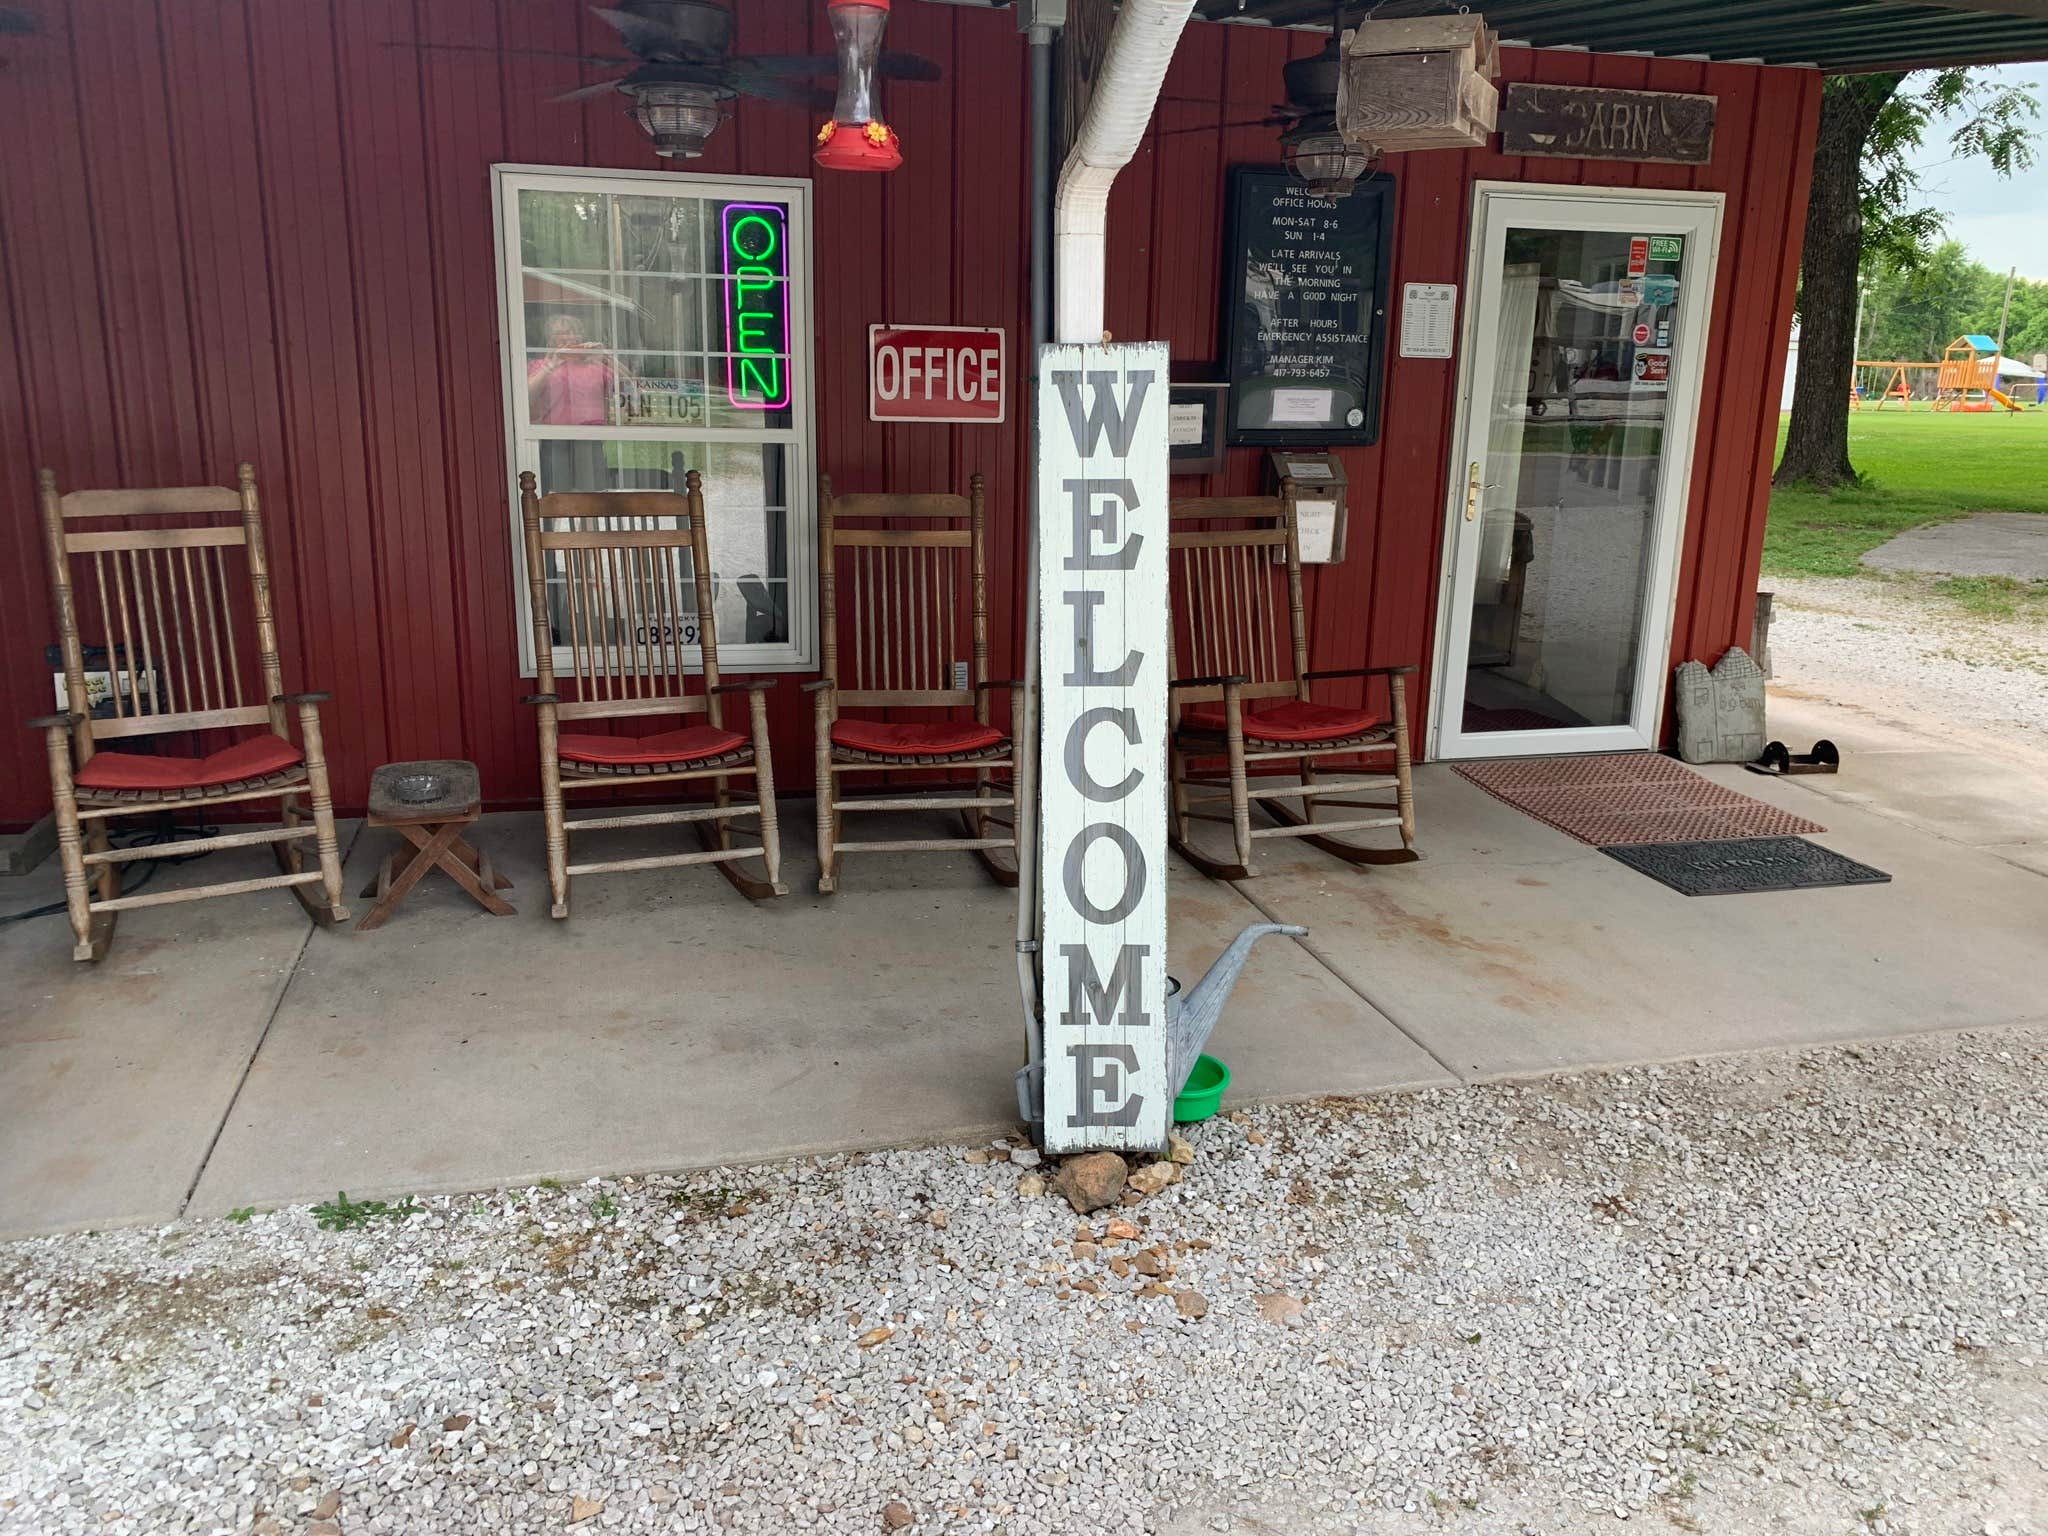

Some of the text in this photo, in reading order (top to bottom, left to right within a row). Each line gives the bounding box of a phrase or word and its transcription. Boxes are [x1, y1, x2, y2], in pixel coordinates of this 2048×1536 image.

[1286, 186, 1311, 196] WELC
[1272, 197, 1337, 209] OFFICE HOURS
[1272, 216, 1339, 229] MON-SAT 8-6
[1284, 230, 1325, 241] SUN 1-4
[1271, 249, 1341, 261] LATE ARRIVALS
[1259, 262, 1353, 275] WE'LL SEE YOU IN
[1275, 278, 1341, 288] THE MORNING
[1254, 290, 1358, 302] HAVE A GOOD NIGHT
[732, 215, 779, 399] OPEN
[1270, 318, 1338, 329] AFTER HOURS
[1257, 332, 1368, 343] EMERGENCY ASSISTANCE
[1269, 354, 1334, 364] MANAGER KIM
[1648, 359, 1668, 367] Good
[876, 345, 999, 402] OFFICE
[1272, 368, 1331, 378] 417-793-6457
[636, 380, 679, 389] KANSAS
[668, 395, 701, 419] 105
[1050, 369, 1156, 1128] WELCOME
